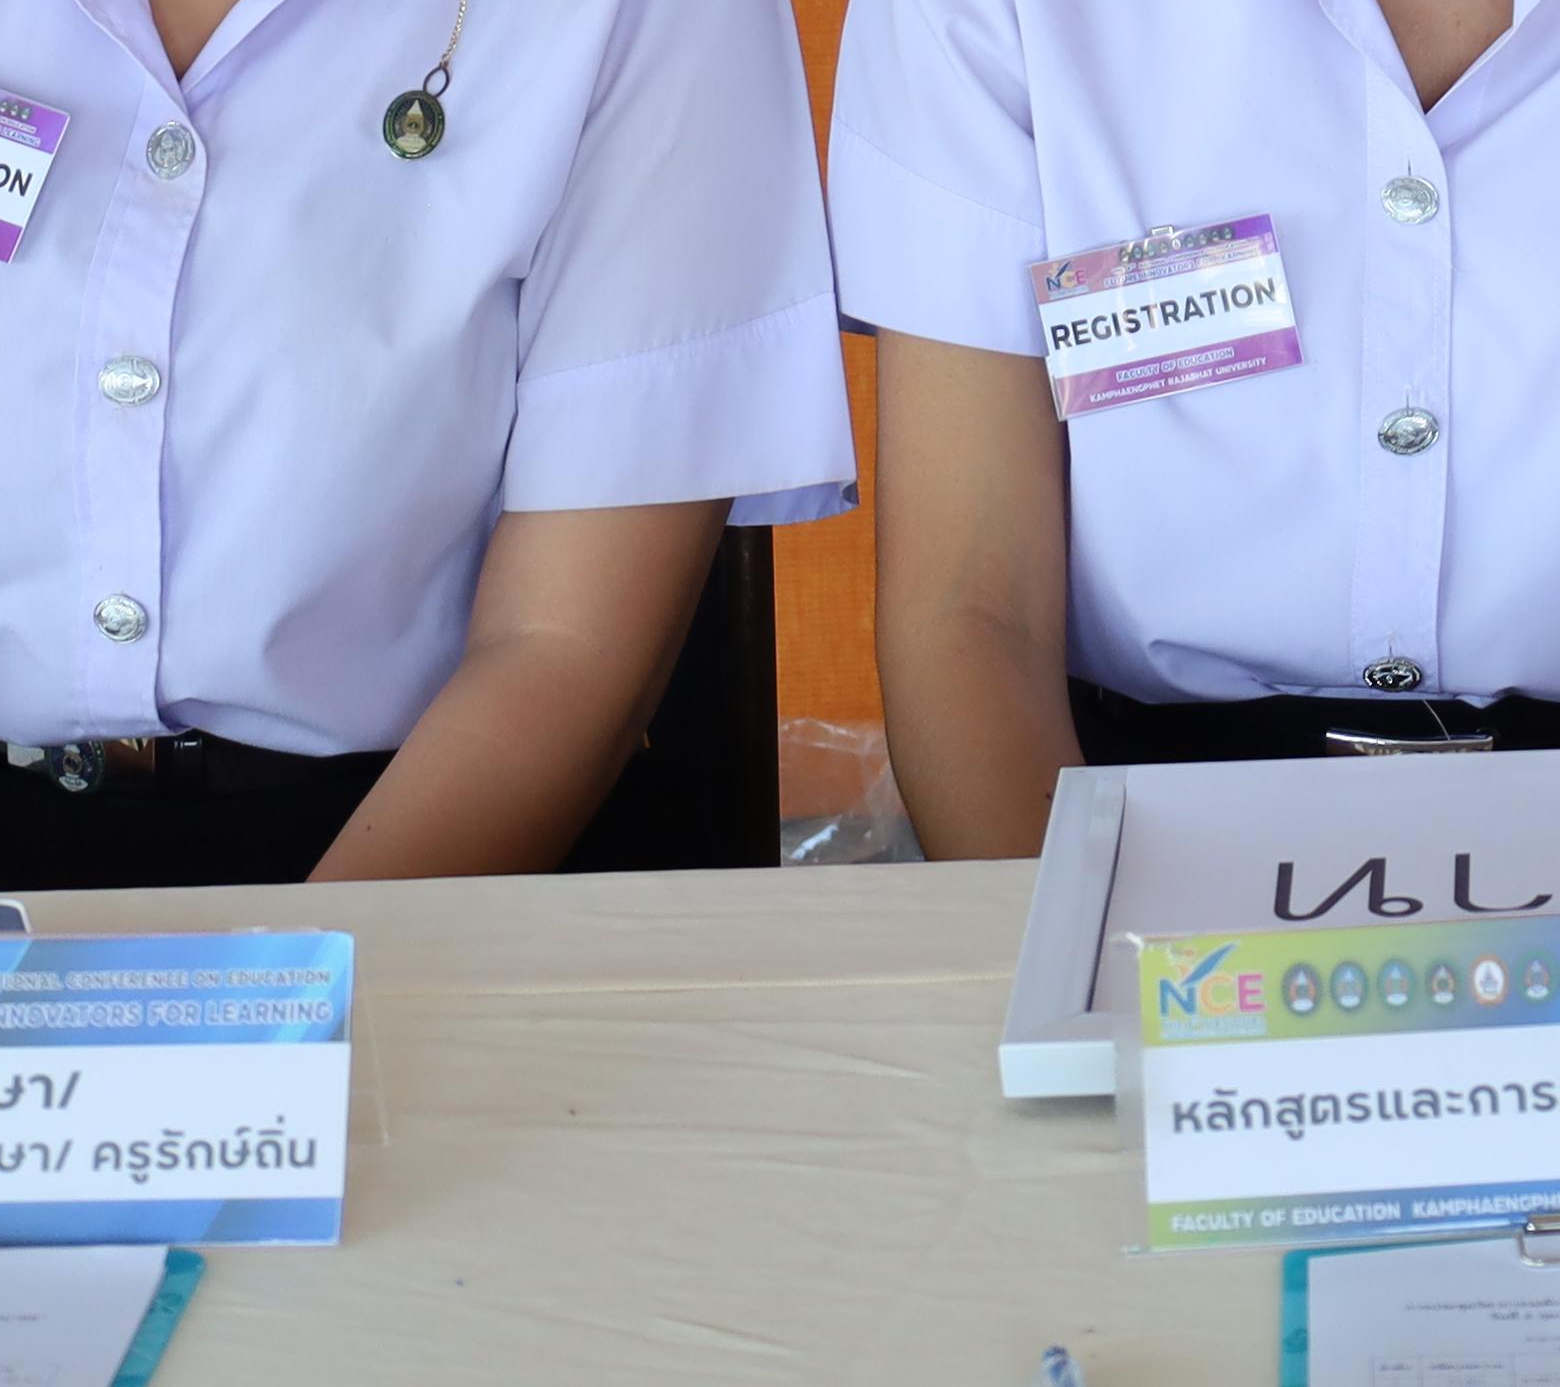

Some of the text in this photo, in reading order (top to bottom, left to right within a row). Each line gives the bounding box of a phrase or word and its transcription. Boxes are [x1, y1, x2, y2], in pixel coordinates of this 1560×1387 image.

[1050, 277, 1277, 351] REGISTRATION
[1116, 346, 1236, 383] FACULTY OF EDUCATION
[1216, 357, 1268, 376] UNIVERSITY
[66, 970, 188, 990] CONFERENCE
[193, 970, 221, 988] ON
[227, 968, 331, 987] EDUCATION
[1160, 974, 1266, 1016] NCE
[148, 999, 200, 1026] FOR
[206, 999, 332, 1025] LEARNING
[92, 1115, 318, 1184] ครูรักษ์ถิ่น
[1172, 1208, 1255, 1232] FACULTY
[1261, 1208, 1288, 1227] OF
[1293, 1201, 1401, 1226] EDUCATION
